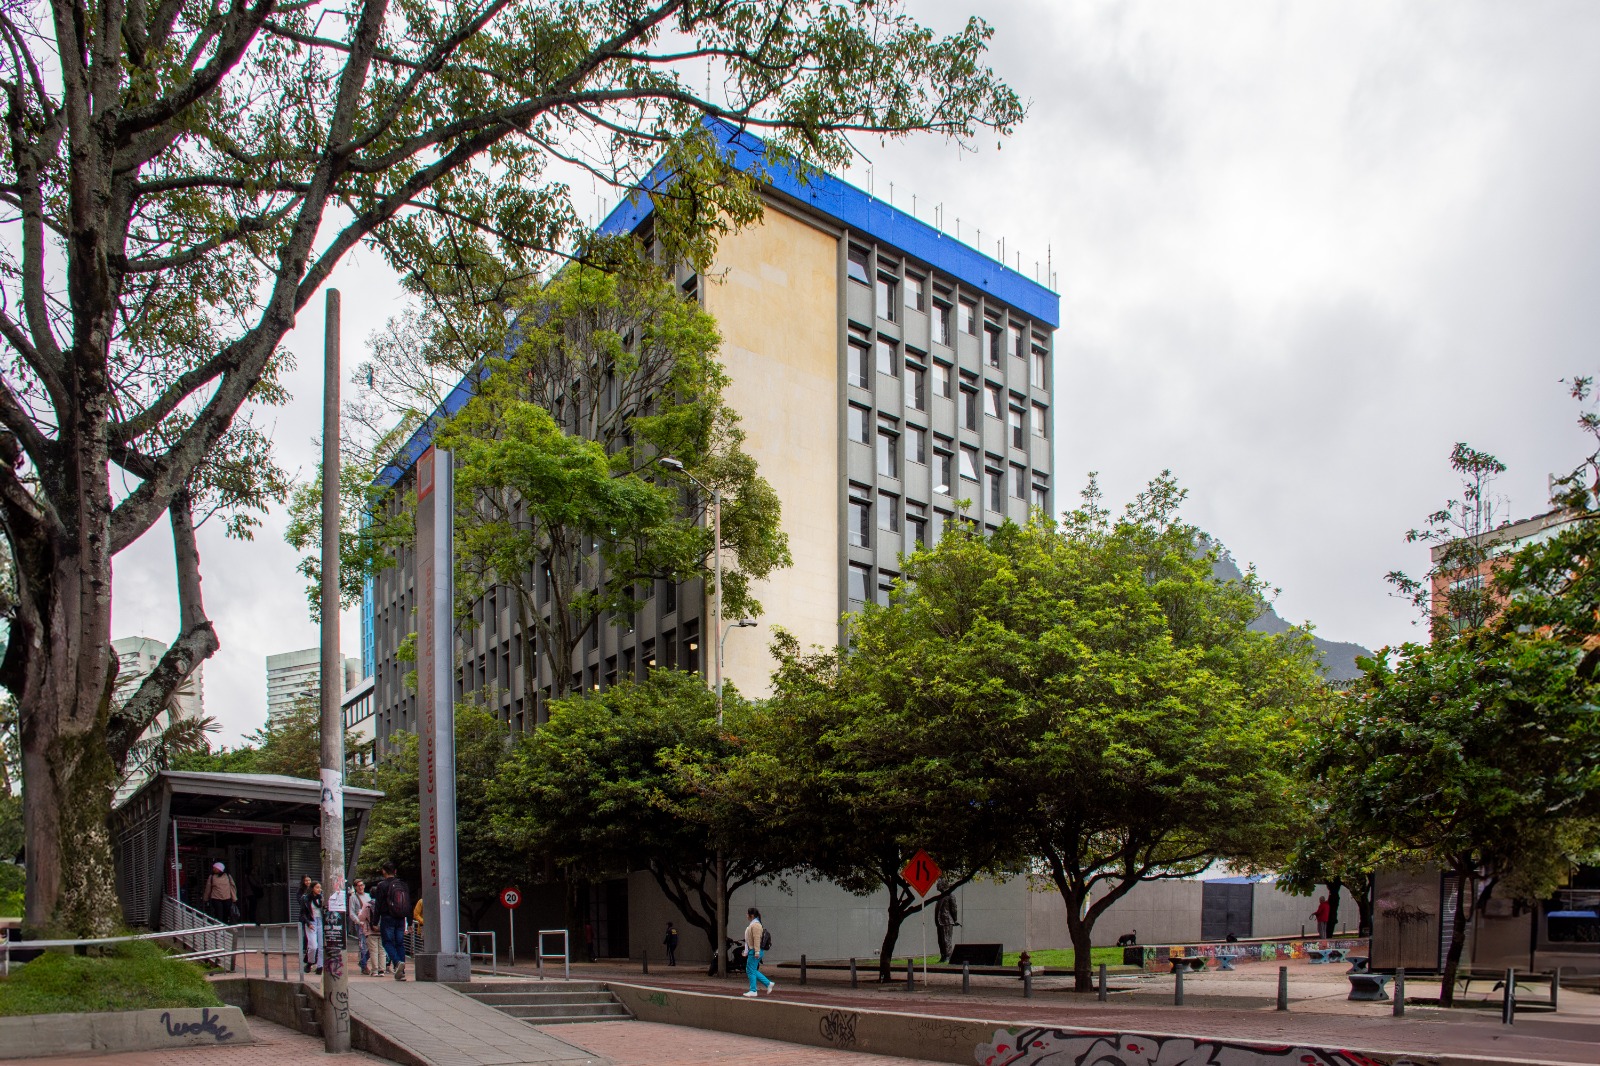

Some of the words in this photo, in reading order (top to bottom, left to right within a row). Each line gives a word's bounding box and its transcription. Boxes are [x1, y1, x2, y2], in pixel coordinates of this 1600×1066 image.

[425, 662, 433, 735] Colombo
[428, 807, 437, 855] Aguas
[506, 893, 517, 902] 20
